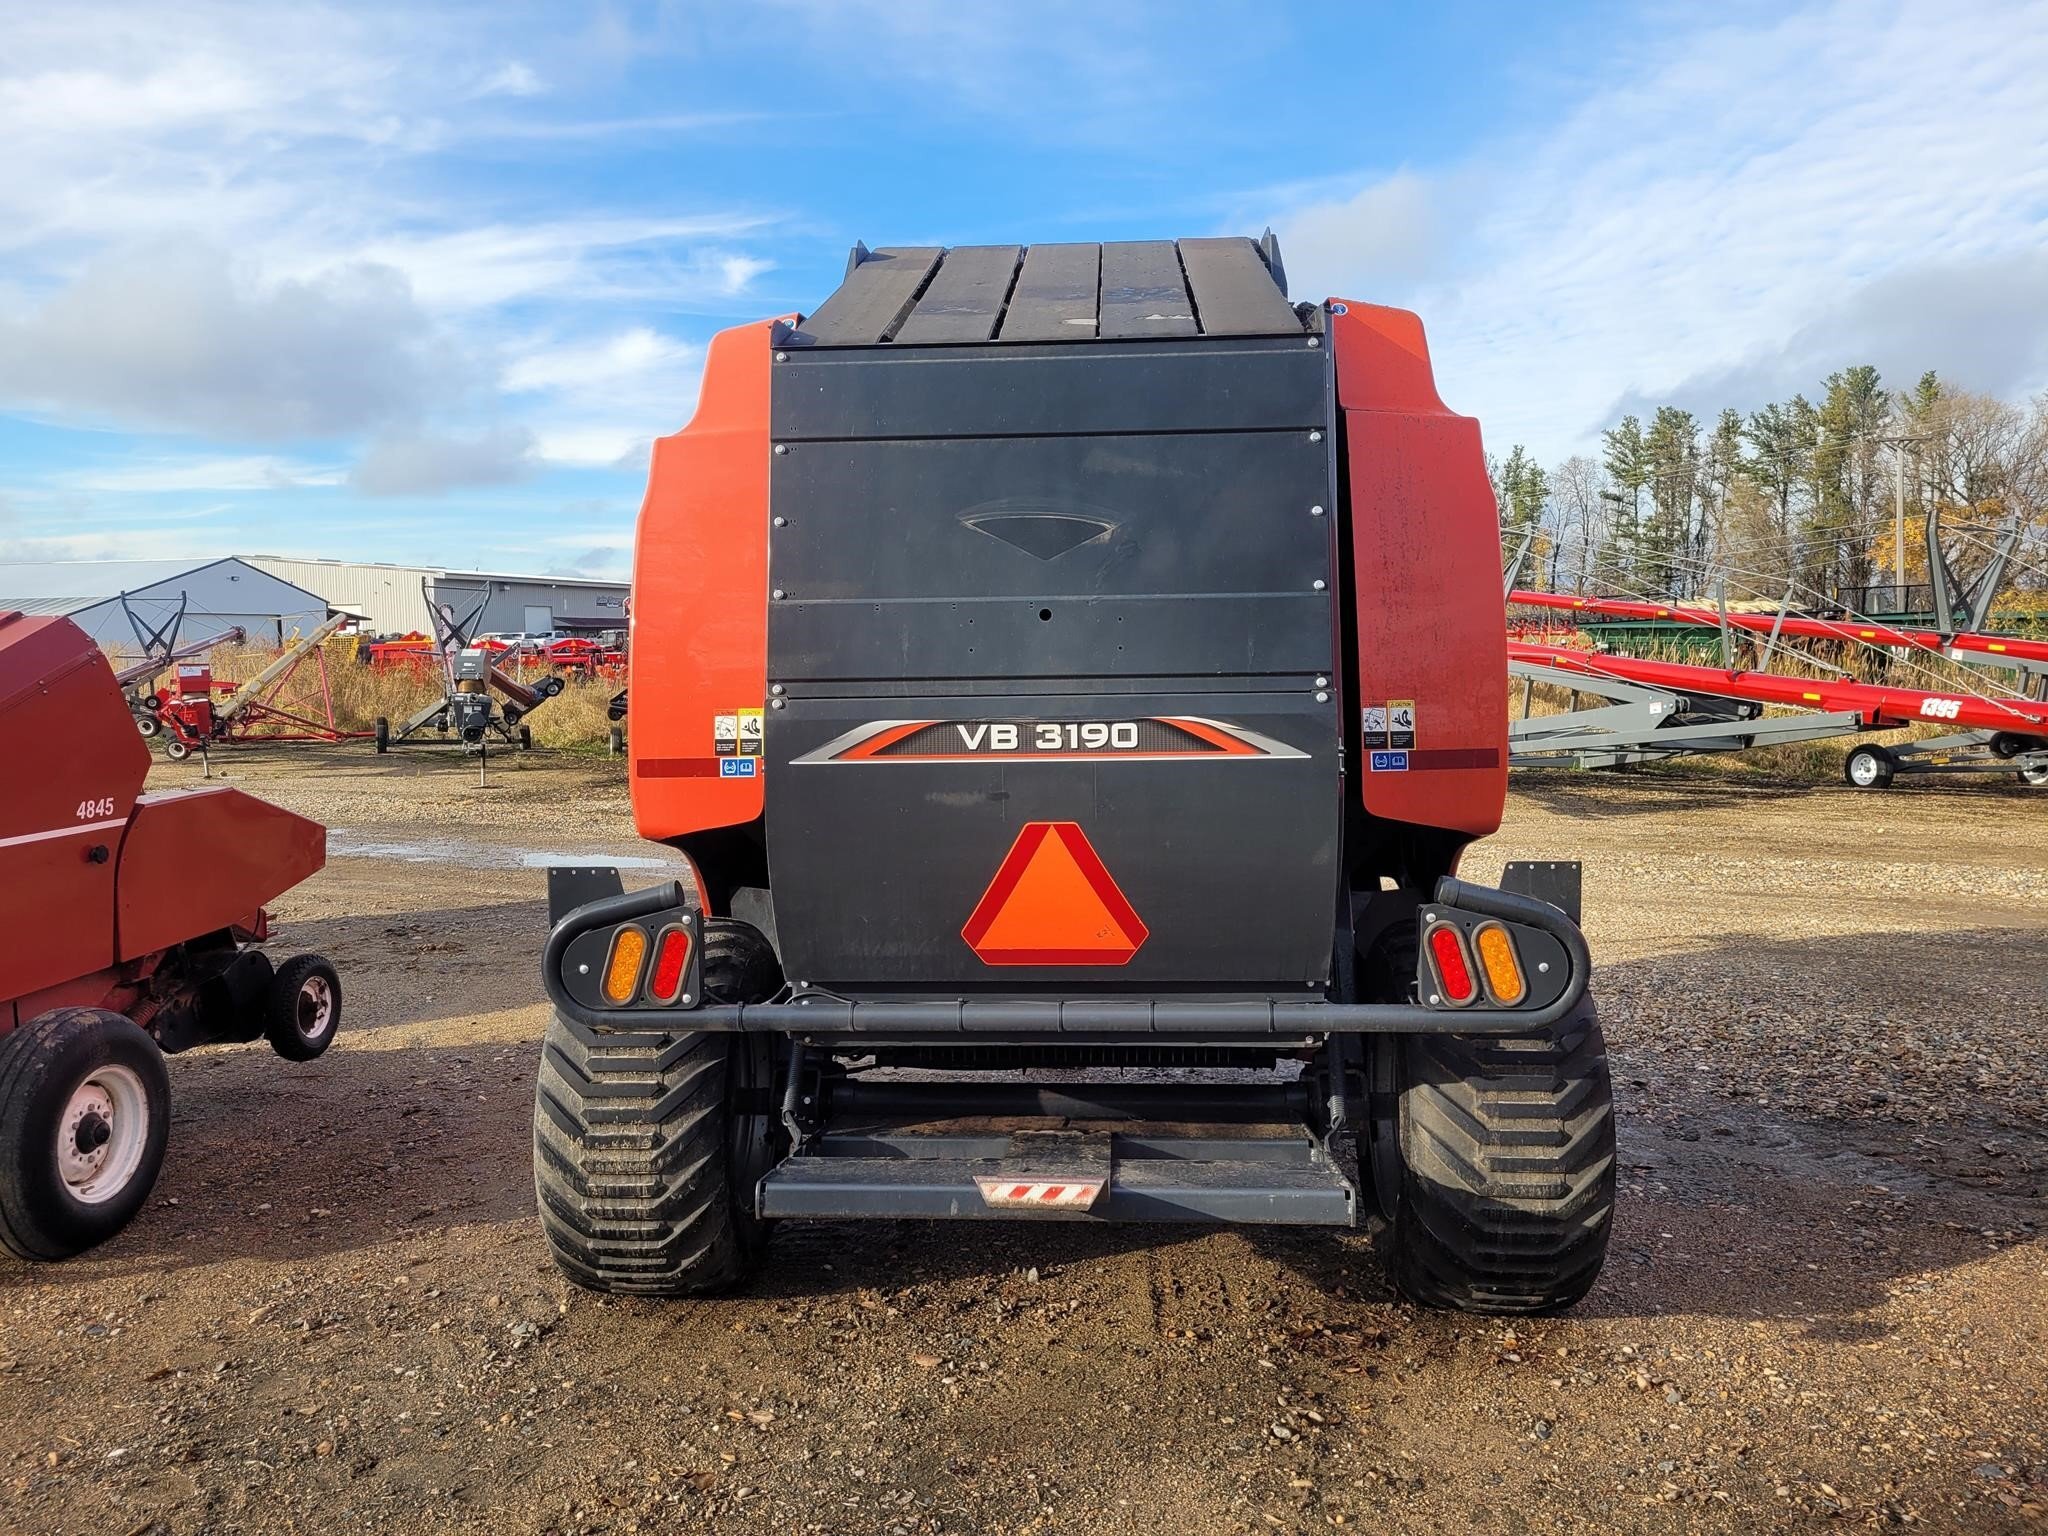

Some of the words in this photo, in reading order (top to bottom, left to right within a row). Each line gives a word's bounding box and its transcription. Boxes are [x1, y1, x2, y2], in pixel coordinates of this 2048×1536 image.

[1920, 698, 1963, 719] 1395
[956, 724, 1018, 750] VB
[1035, 723, 1138, 749] 3190
[76, 797, 114, 819] 4845
